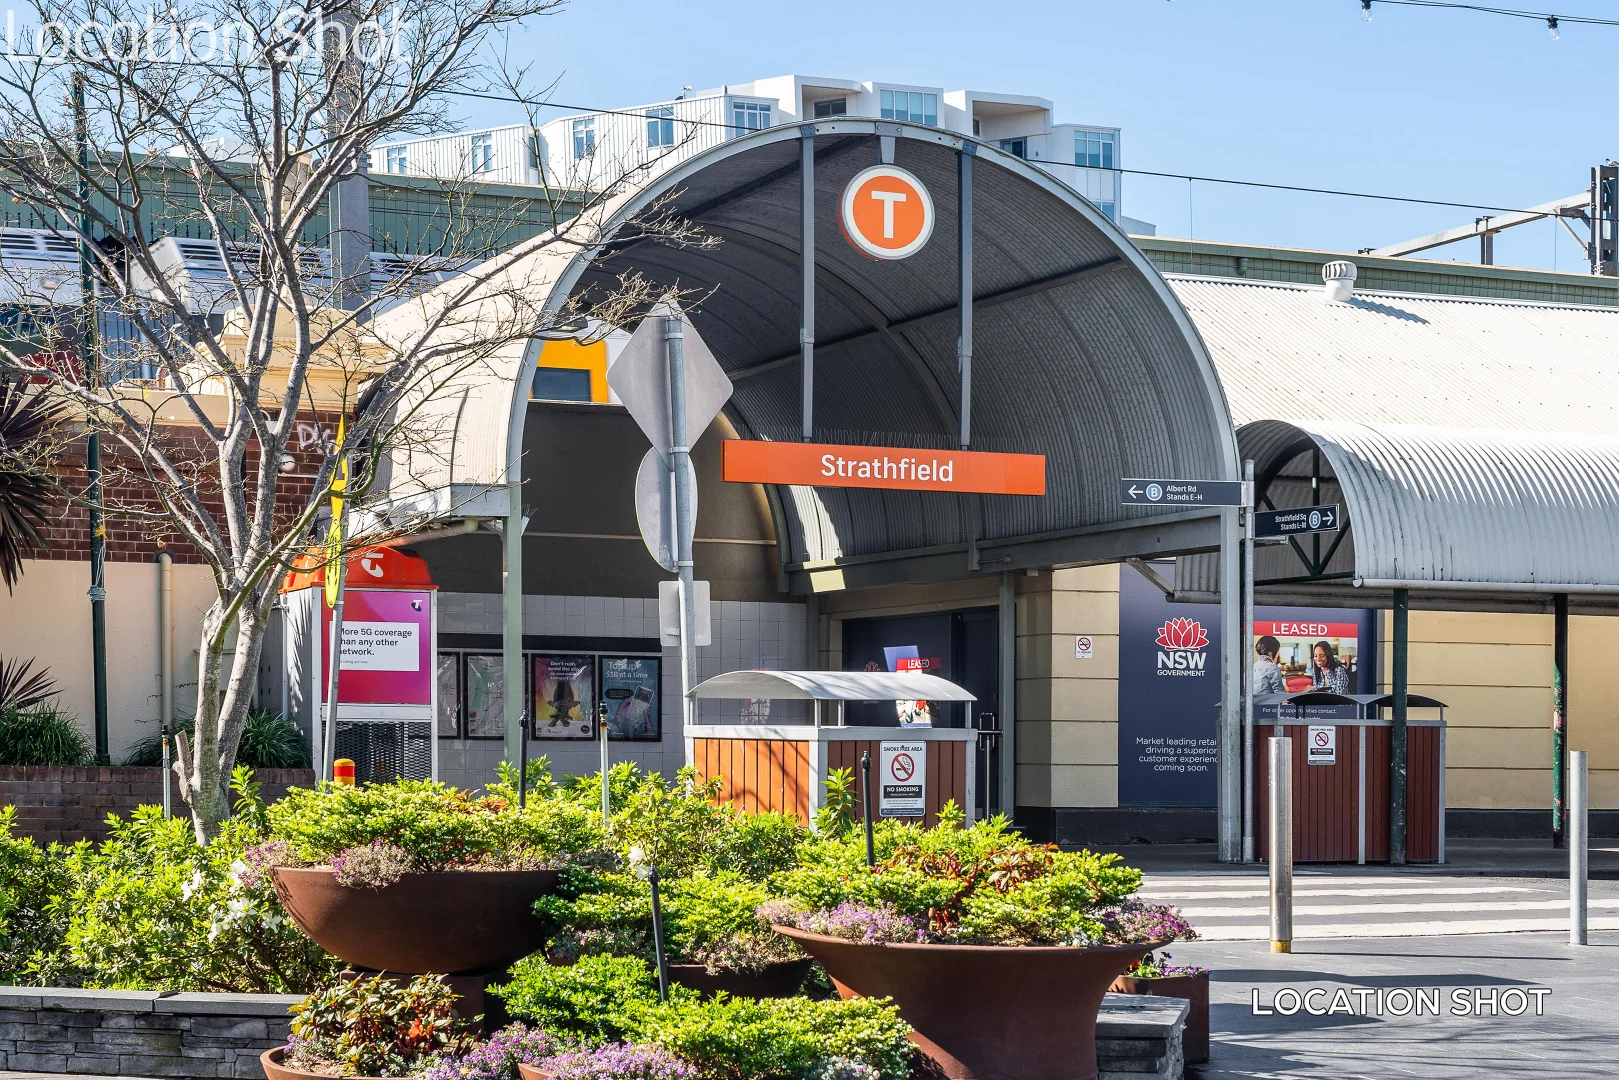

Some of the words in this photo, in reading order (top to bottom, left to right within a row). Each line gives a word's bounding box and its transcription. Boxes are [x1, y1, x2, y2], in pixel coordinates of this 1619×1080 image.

[871, 190, 907, 239] T
[820, 454, 953, 482] Strathfield
[1166, 493, 1189, 501] Stands
[1190, 493, 1203, 501] E-H
[1274, 514, 1299, 523] Strathfield
[1299, 513, 1307, 521] Sq
[1280, 523, 1297, 531] Stands
[360, 628, 372, 636] 5G
[374, 629, 413, 638] coverage
[1272, 623, 1328, 636] LEASED
[358, 639, 374, 647] any
[907, 659, 930, 669] LEASED
[1157, 651, 1207, 669] NSW
[606, 670, 618, 678] $10
[1157, 669, 1205, 677] GOVERNMENT
[1136, 737, 1164, 745] Market
[1166, 737, 1196, 746] leading
[1145, 746, 1175, 755] driving
[1184, 747, 1217, 755] superior
[1138, 755, 1178, 763] customer
[1179, 755, 1218, 764] experienc
[1154, 764, 1185, 772] coming
